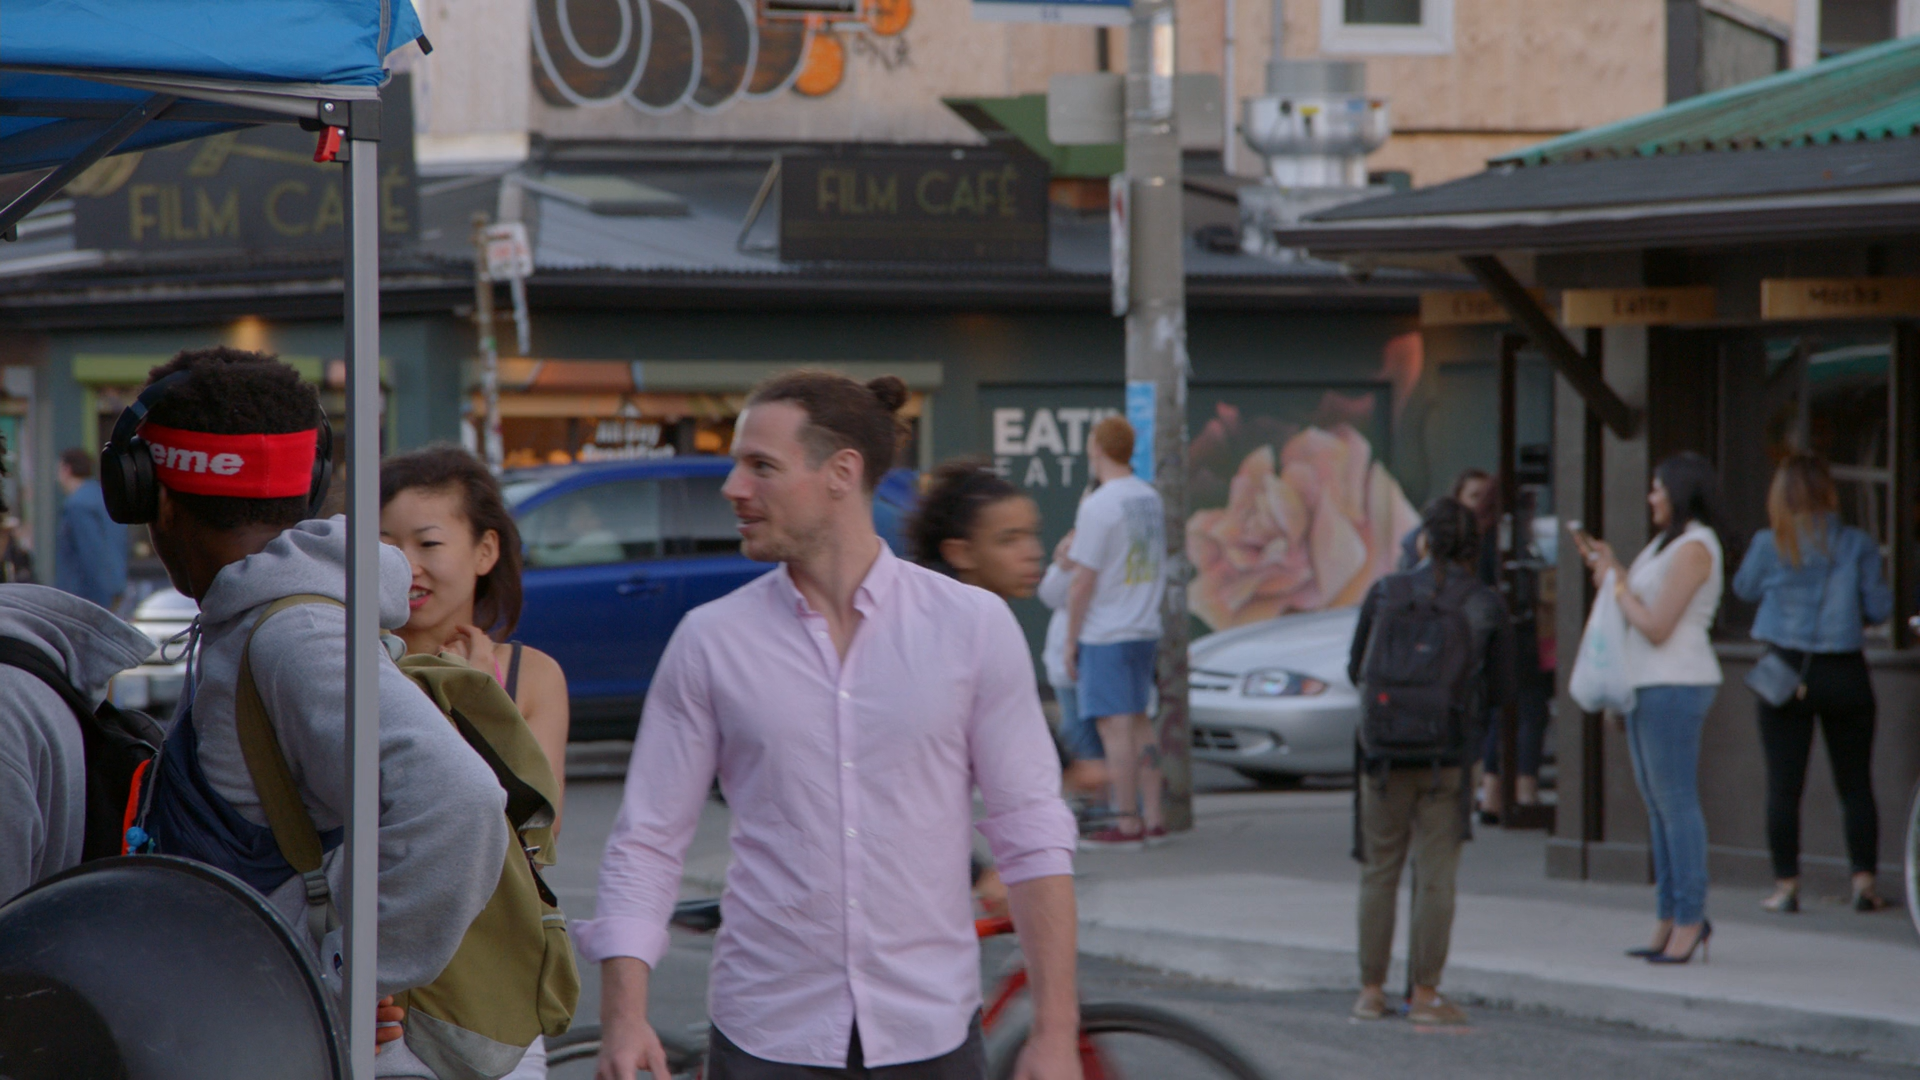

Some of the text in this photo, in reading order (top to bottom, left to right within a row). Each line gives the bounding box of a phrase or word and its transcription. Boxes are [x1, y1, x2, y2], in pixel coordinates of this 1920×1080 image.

[128, 166, 409, 241] FILM CAÉ
[816, 164, 1018, 216] FILM CAFÉ
